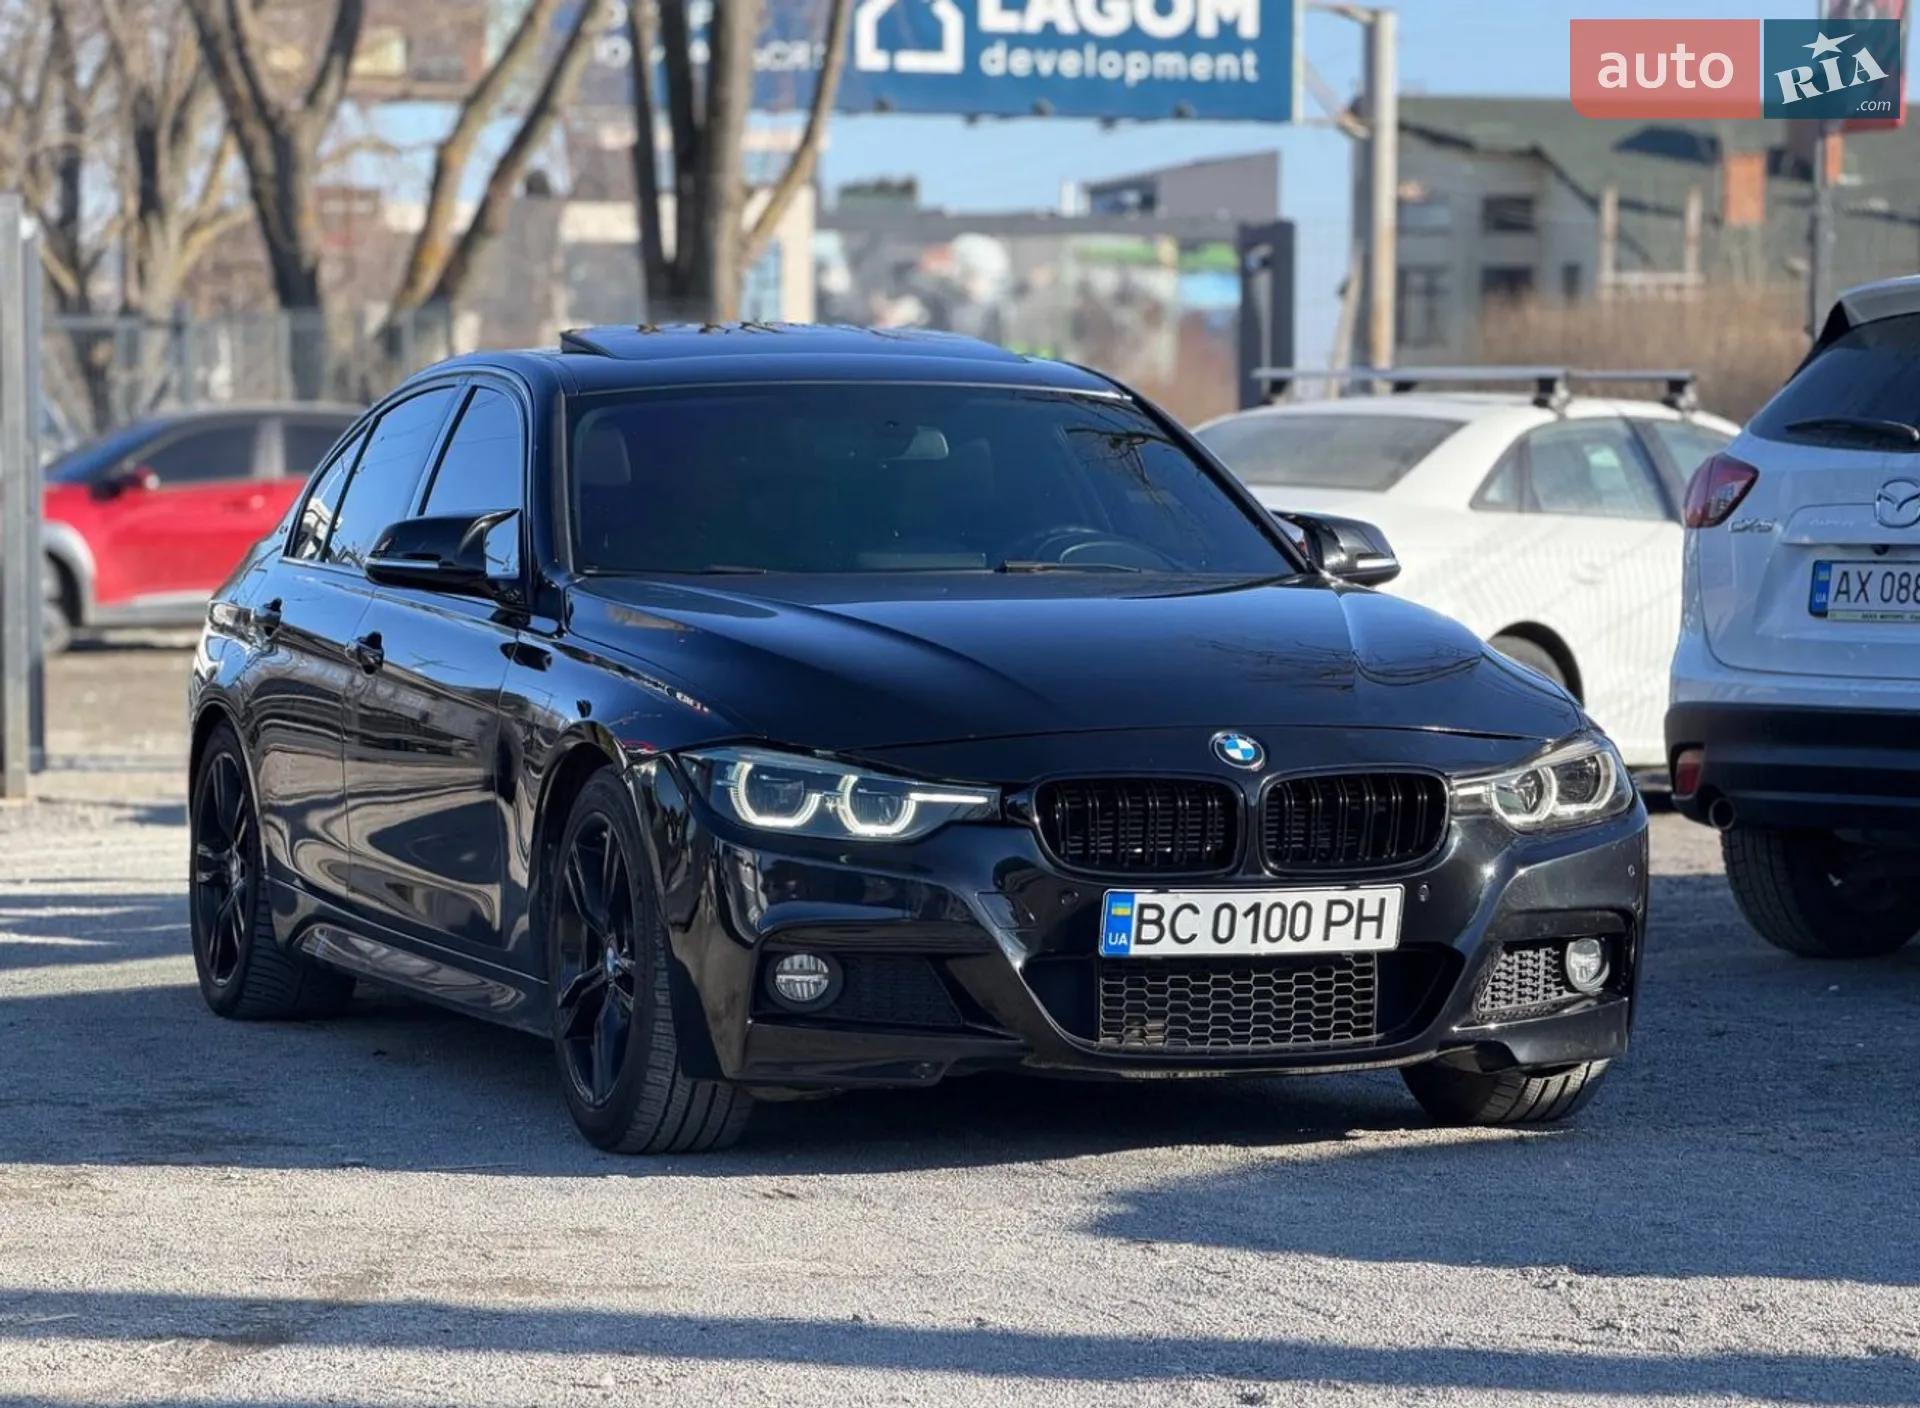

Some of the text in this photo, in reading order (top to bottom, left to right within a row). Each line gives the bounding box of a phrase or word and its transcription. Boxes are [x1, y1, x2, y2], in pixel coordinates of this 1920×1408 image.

[978, 0, 1260, 39] LAGOM
[979, 38, 1260, 88] development
[1833, 570, 1873, 603] AX
[1108, 932, 1129, 946] UA
[1134, 897, 1386, 946] BC 0100 PH
